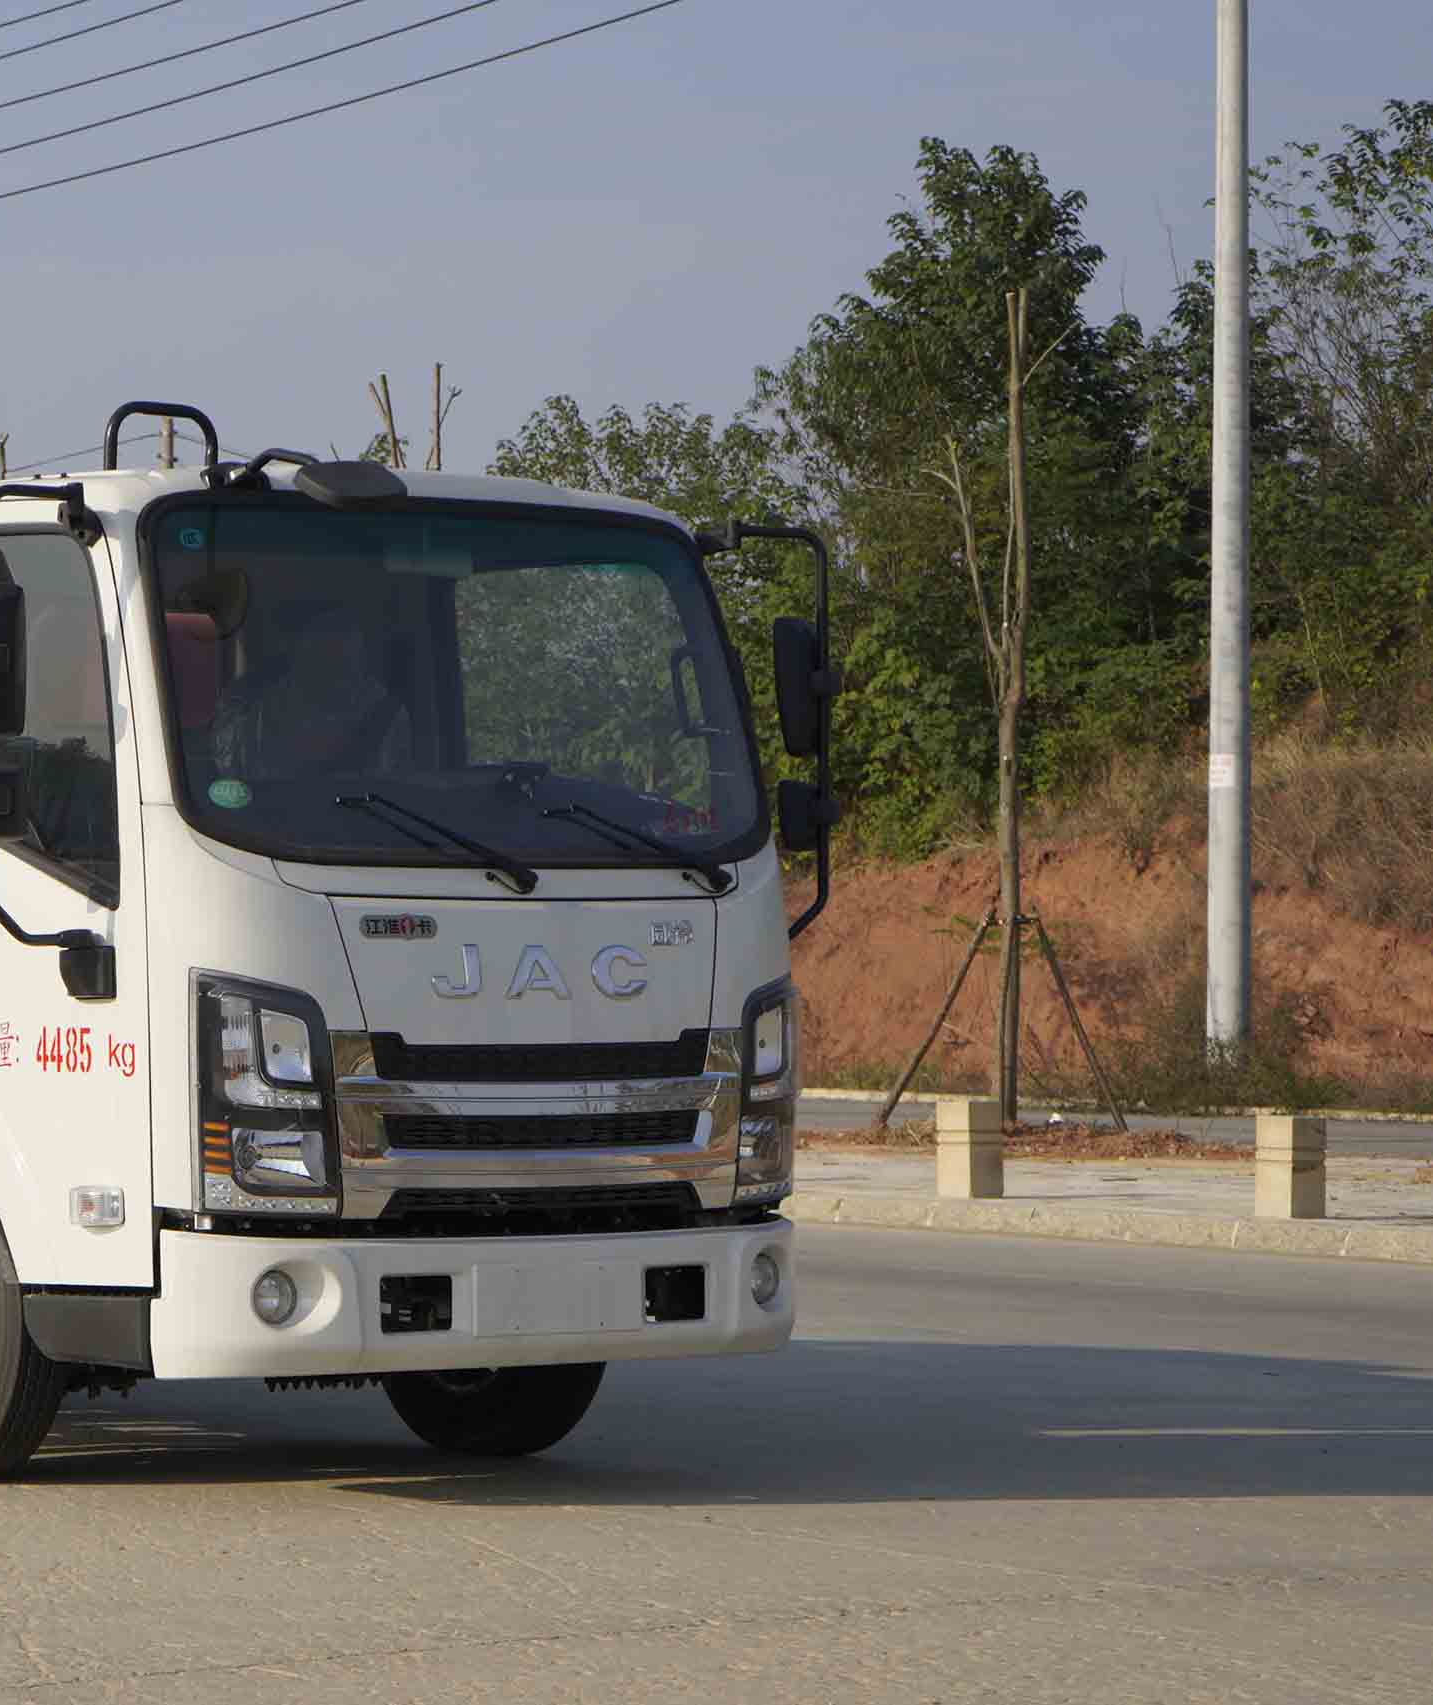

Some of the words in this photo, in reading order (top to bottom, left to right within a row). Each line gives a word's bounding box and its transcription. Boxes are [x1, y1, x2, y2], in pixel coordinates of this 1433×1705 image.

[431, 943, 648, 1001] JAC
[36, 1026, 93, 1073] 4485
[107, 1033, 136, 1077] kg
